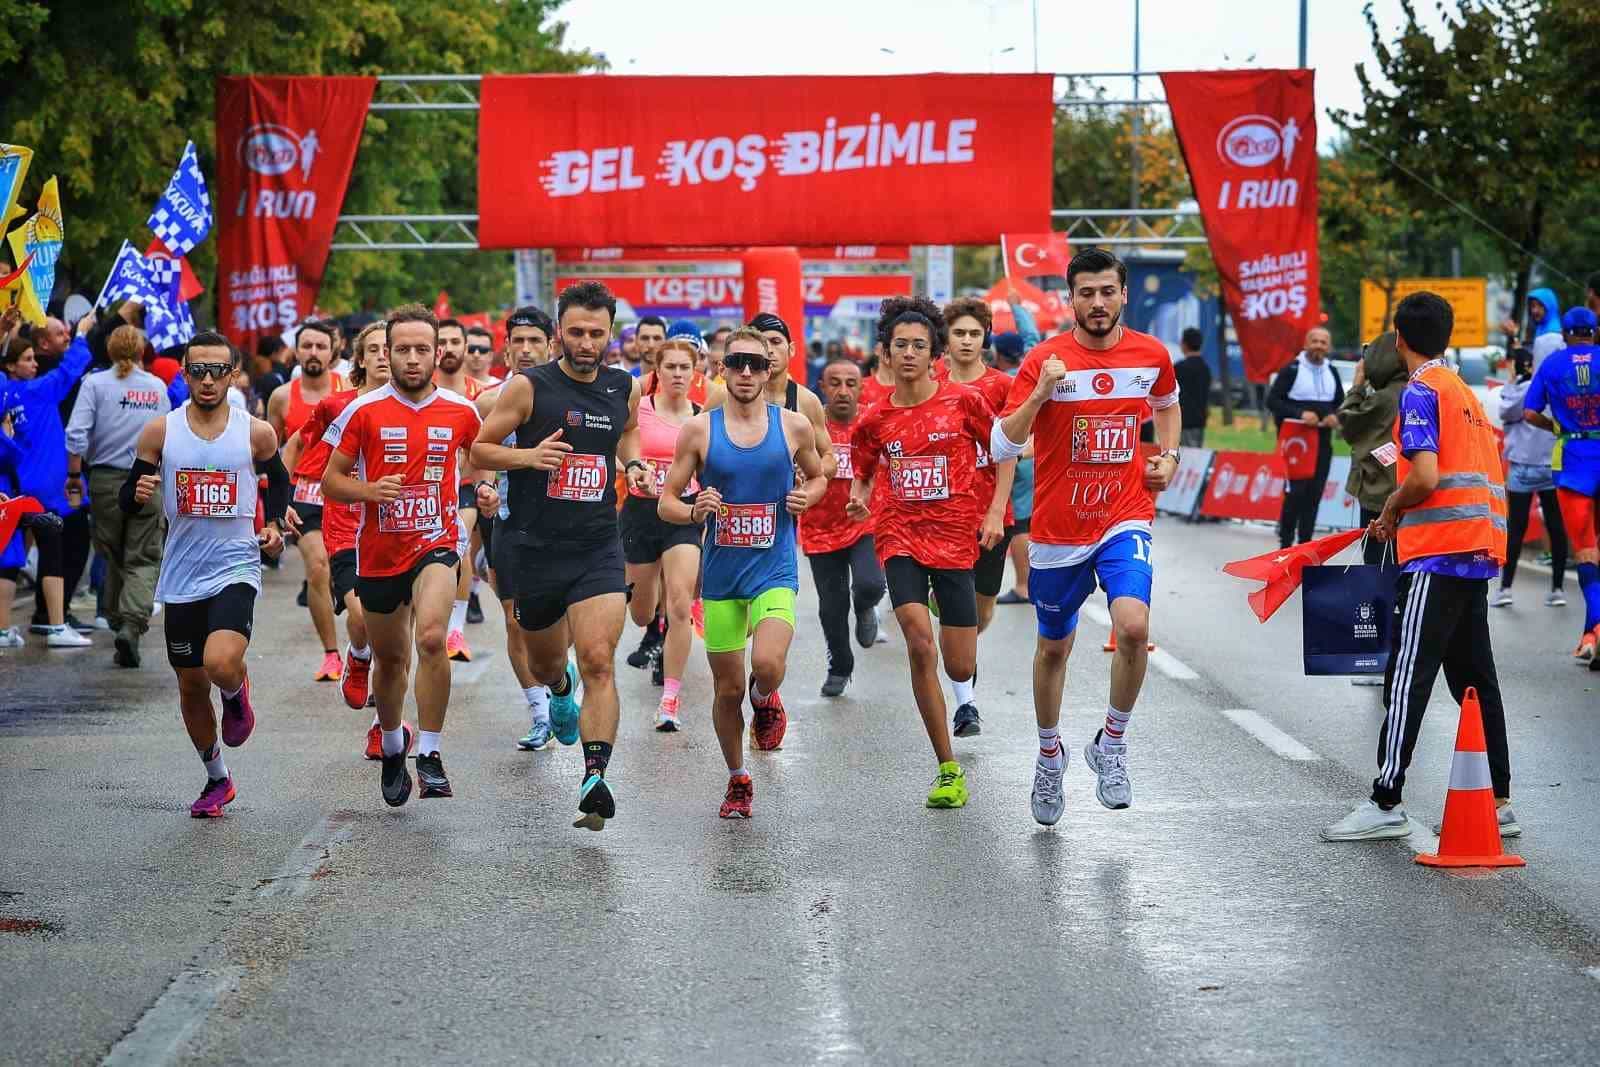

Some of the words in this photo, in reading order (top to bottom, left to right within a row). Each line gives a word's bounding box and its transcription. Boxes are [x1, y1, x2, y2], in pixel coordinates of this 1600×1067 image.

[542, 146, 645, 198] GEL
[660, 133, 768, 192] KOŞ
[773, 111, 978, 177] BİZİMLE
[1218, 179, 1231, 209] I
[1237, 177, 1298, 209] RUN
[255, 189, 316, 219] RUN
[1242, 284, 1307, 320] KOŞ
[127, 391, 160, 404] PLUS
[1094, 428, 1128, 449] 1171
[566, 466, 601, 489] 1150
[902, 468, 943, 489] 2975
[193, 483, 230, 504] 1166
[923, 488, 944, 497] SPX
[1066, 480, 1122, 506] 100
[211, 505, 233, 514] SPX
[394, 497, 437, 519] 3730
[730, 516, 773, 535] 3588
